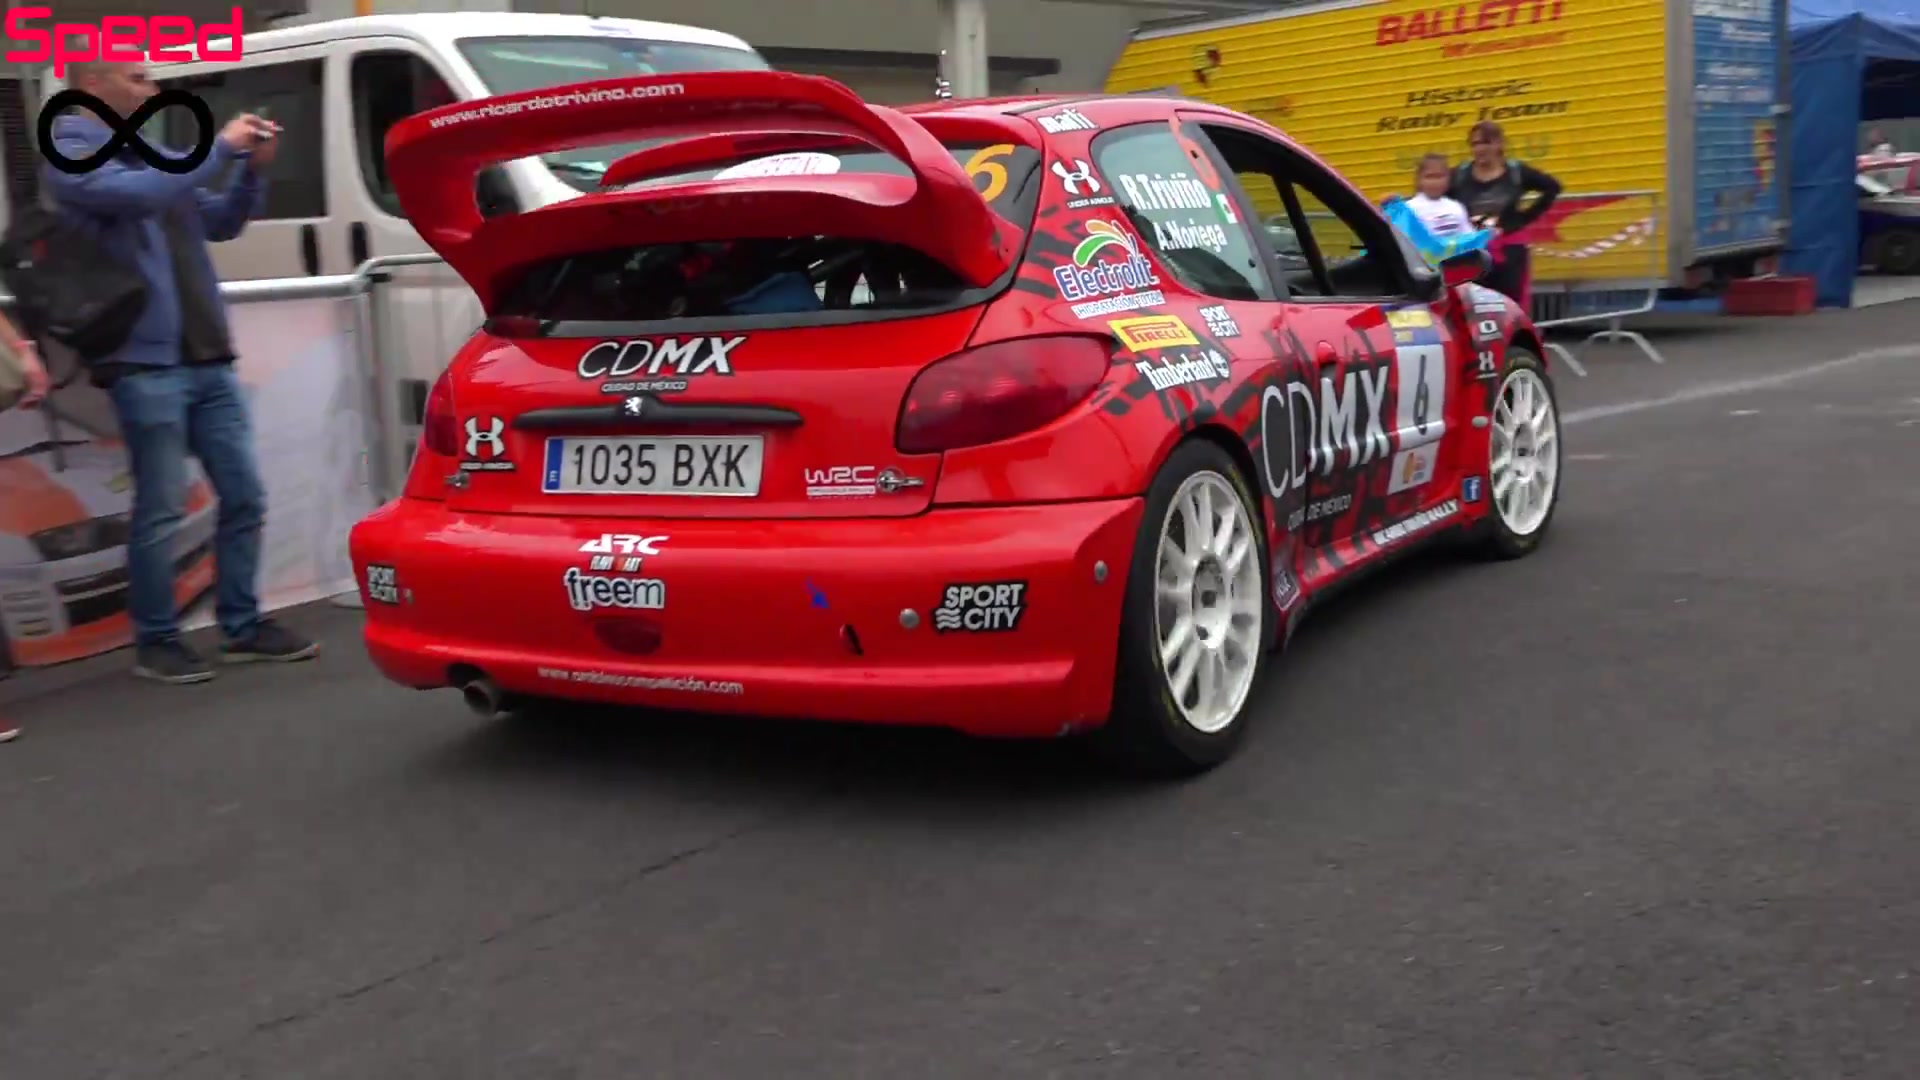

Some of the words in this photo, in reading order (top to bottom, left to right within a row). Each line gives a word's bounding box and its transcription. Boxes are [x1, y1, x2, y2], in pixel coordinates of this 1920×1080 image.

[1405, 80, 1532, 107] Historic
[1376, 113, 1466, 132] Rally
[1479, 101, 1570, 121] Team
[964, 143, 1015, 202] 6
[1153, 218, 1228, 252] A.Noriega
[1055, 254, 1160, 301] Electrolit
[1121, 321, 1188, 344] PIRELLI
[578, 335, 747, 378] CDMX
[1413, 354, 1429, 436] 6
[1261, 366, 1390, 498] CDMX
[575, 445, 656, 486] 1035
[672, 444, 750, 487] BXK
[805, 465, 875, 484] WRC
[577, 533, 670, 555] ARC
[567, 570, 661, 608] freem
[945, 584, 1023, 608] SPORT
[964, 607, 1020, 630] CITY
